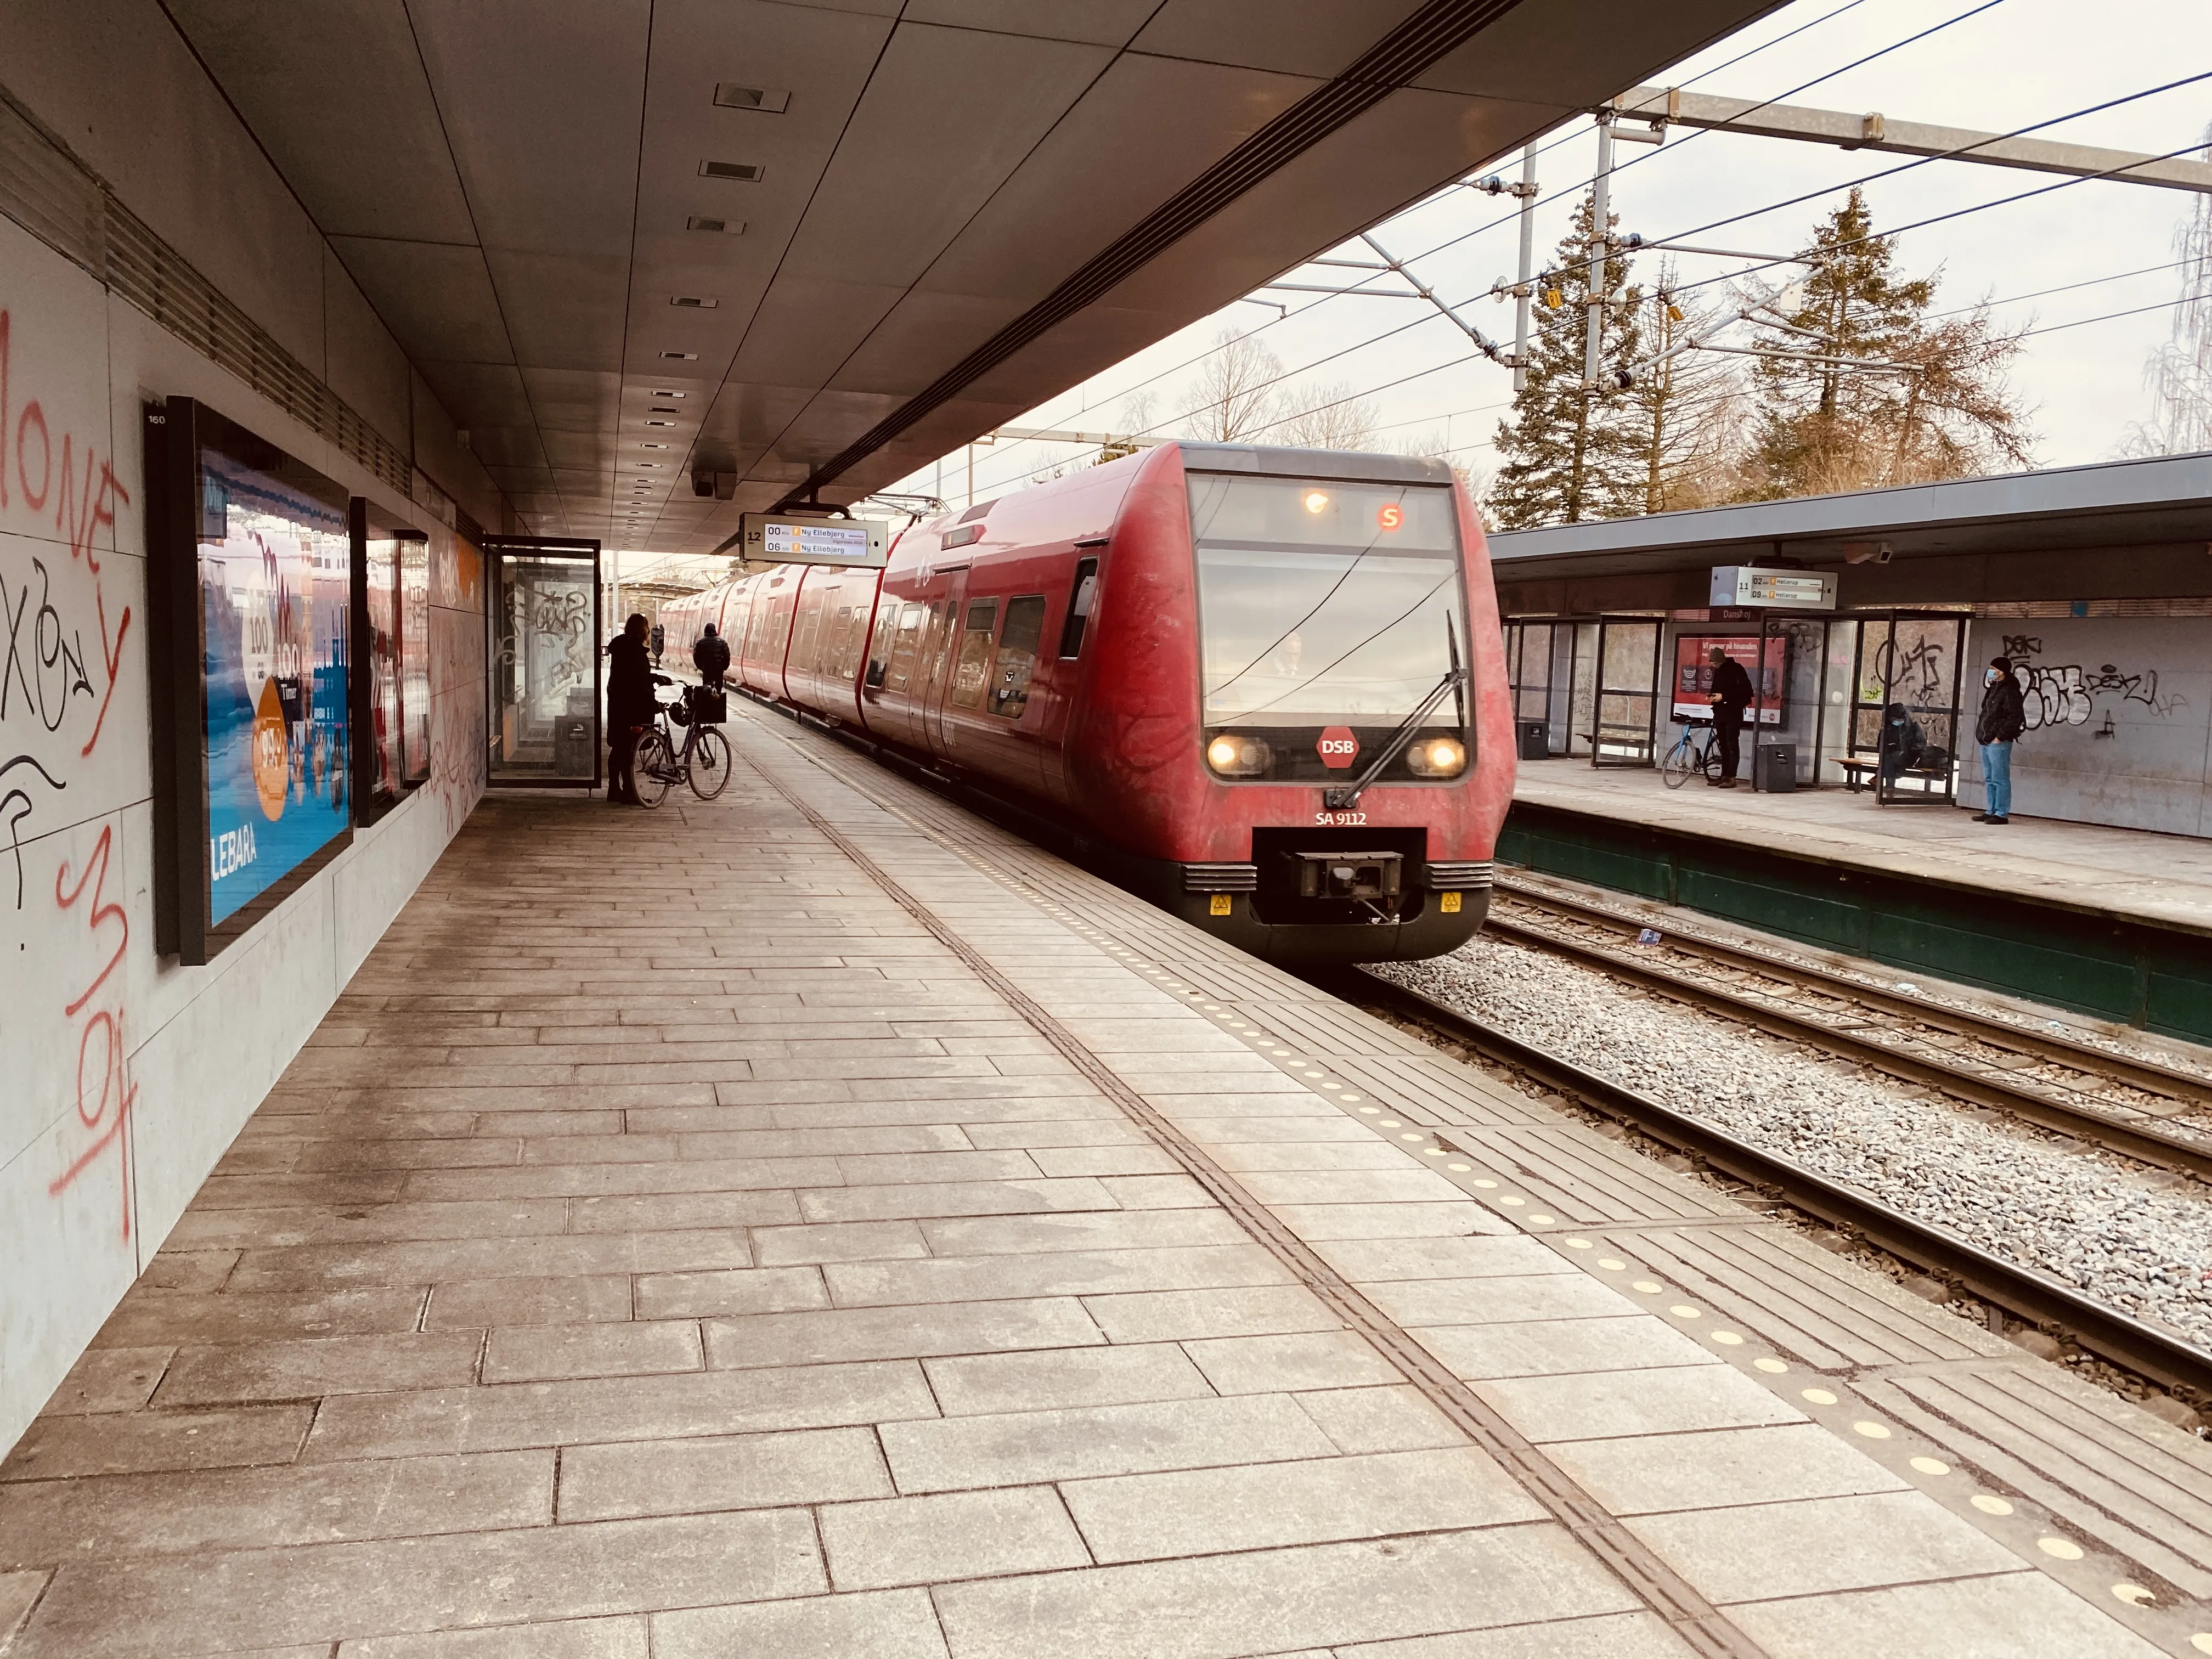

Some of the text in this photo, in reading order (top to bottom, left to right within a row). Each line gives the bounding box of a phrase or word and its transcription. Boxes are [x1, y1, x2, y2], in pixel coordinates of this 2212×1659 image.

[148, 415, 166, 424] 160
[1383, 508, 1398, 527] S
[0, 309, 132, 758] ONEY
[747, 532, 761, 541] 12
[768, 527, 781, 535] 00
[813, 529, 845, 539] Ellebjerg
[768, 543, 781, 551] 06
[802, 545, 811, 553] Ny
[813, 545, 845, 555] Ellebjerg
[250, 616, 268, 654] 100
[1702, 641, 1709, 650] Vi
[1726, 641, 1733, 651] på
[1733, 642, 1757, 650] hinanden
[276, 643, 300, 679] 100
[1322, 740, 1355, 754] DSB
[1316, 812, 1367, 826] SA 9112
[211, 821, 257, 882] LEBARA
